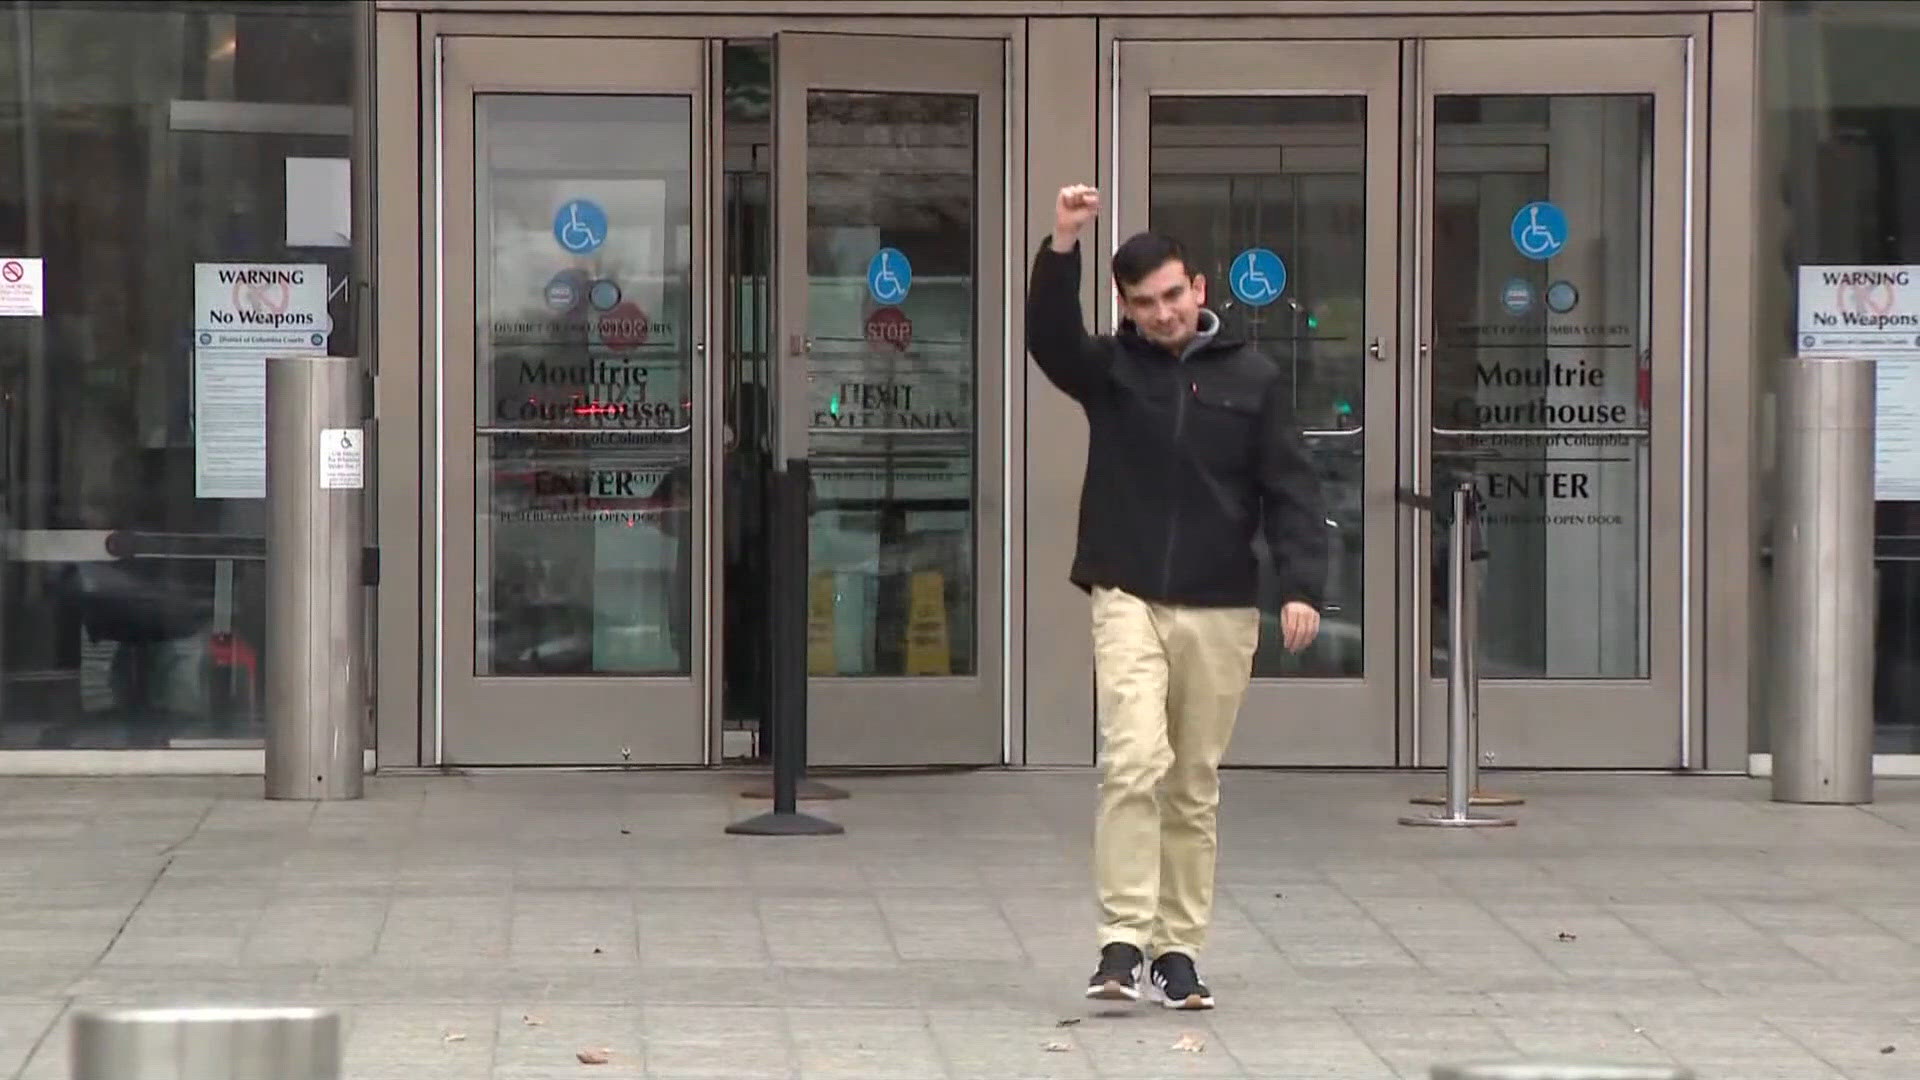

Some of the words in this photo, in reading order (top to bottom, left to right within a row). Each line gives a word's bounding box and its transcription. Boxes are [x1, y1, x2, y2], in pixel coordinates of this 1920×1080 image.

[219, 270, 304, 285] WARNING
[1823, 272, 1909, 286] WARNING
[210, 310, 233, 324] No
[239, 310, 314, 329] Weapons
[1814, 312, 1838, 326] No
[1842, 312, 1919, 330] Weapons
[868, 321, 910, 338] STOP
[519, 356, 648, 385] Moultrie
[1474, 359, 1605, 387] Moultrie
[1453, 397, 1627, 424] Courthouse
[1563, 433, 1630, 447] Columbia
[1488, 473, 1589, 498] ENTER
[1553, 515, 1584, 525] OPEN
[1587, 514, 1623, 525] DOOR
